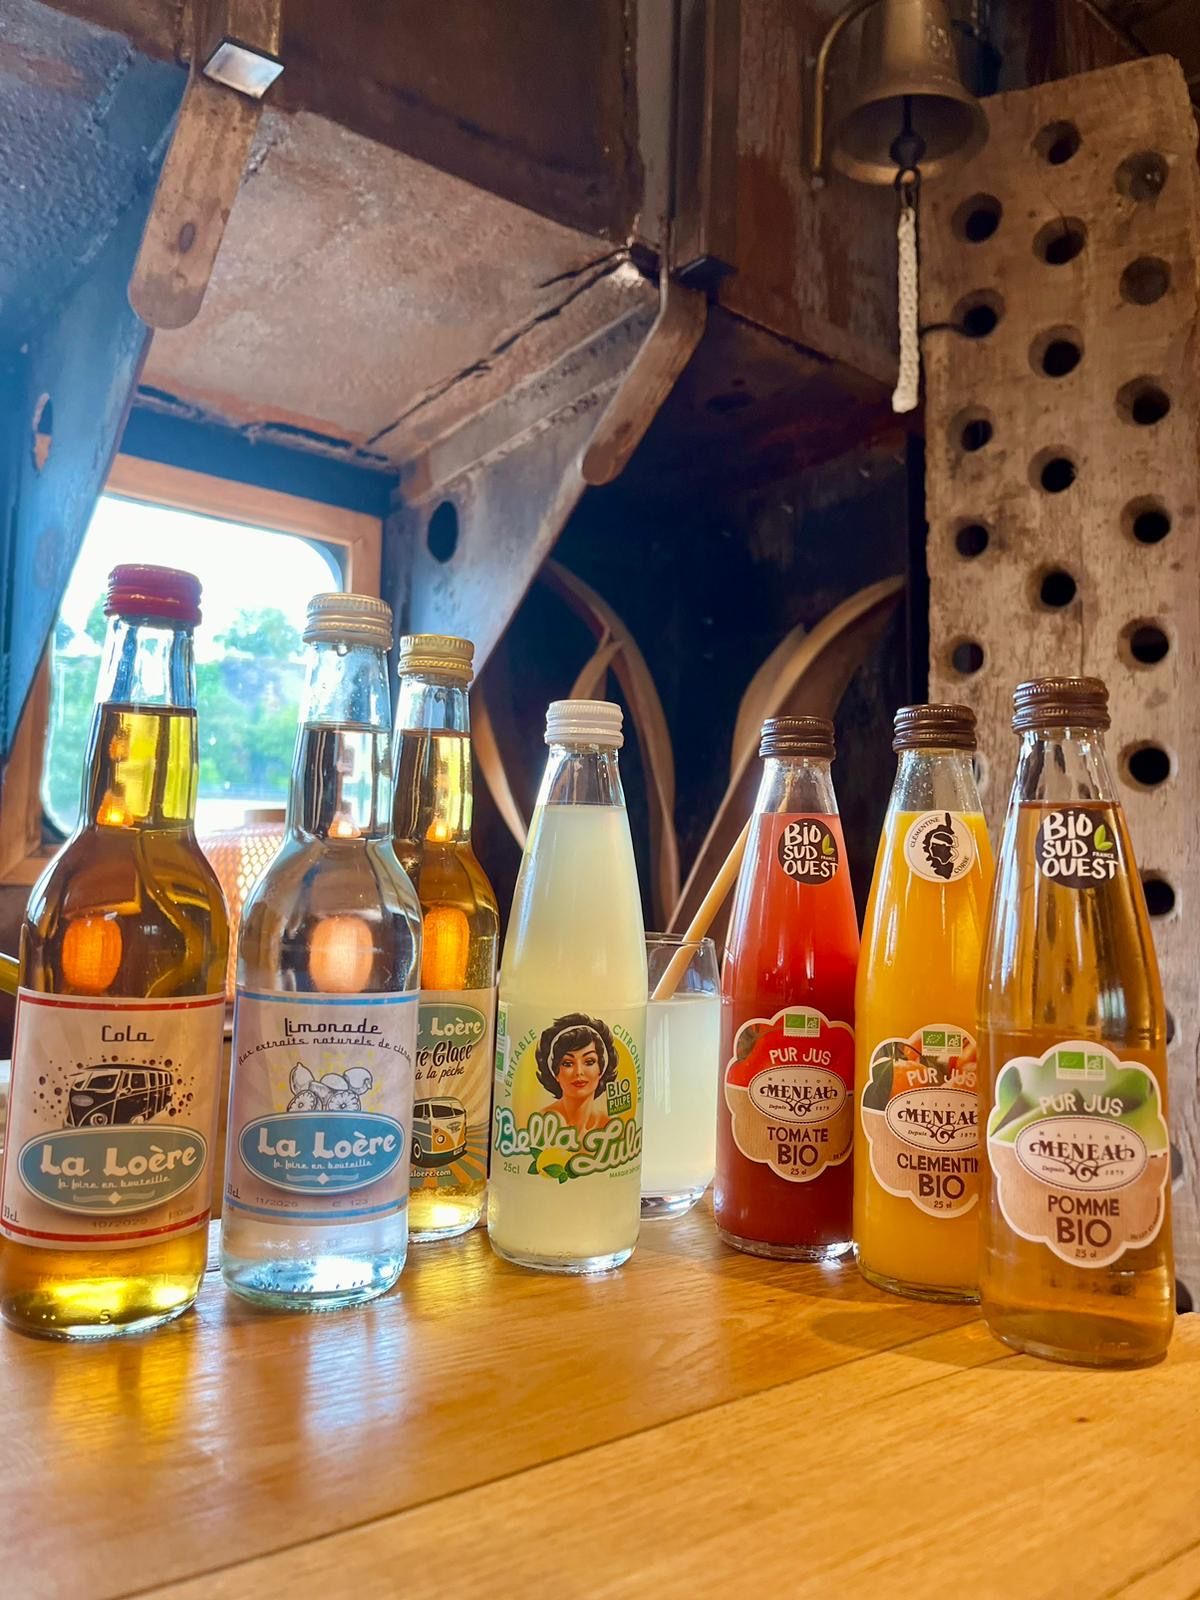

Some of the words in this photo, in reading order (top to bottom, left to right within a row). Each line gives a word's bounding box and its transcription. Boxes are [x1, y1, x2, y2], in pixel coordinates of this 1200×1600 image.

[783, 845, 818, 860] SUD
[1041, 839, 1088, 858] SUD
[1092, 851, 1115, 859] FRANCE
[783, 860, 839, 878] OUEST
[953, 856, 970, 874] CORSE
[1042, 857, 1119, 880] OUEST
[101, 1025, 155, 1043] Cola
[284, 1017, 383, 1037] Limonade
[430, 1017, 482, 1036] Loère
[256, 1035, 309, 1052] extraits
[313, 1036, 375, 1047] naturels
[378, 1037, 392, 1049] de
[432, 1040, 473, 1067] Glacé
[504, 1028, 537, 1098] VÉRITABLE
[769, 1046, 798, 1065] PUR
[802, 1047, 832, 1065] JUS
[426, 1065, 438, 1079] la
[906, 1067, 938, 1087] PUR
[944, 1069, 977, 1088] JUS
[608, 1079, 630, 1098] BIO
[760, 1084, 838, 1100] MENEAU
[609, 1094, 630, 1109] PULPE
[1039, 1095, 1077, 1115] PUR
[1083, 1095, 1124, 1117] JUS
[495, 1107, 580, 1156] Bella
[767, 1127, 829, 1142] TOMATE
[258, 1127, 301, 1157] La
[312, 1131, 397, 1159] Loère
[1029, 1139, 1136, 1161] MENEAU
[40, 1144, 90, 1176] La
[103, 1145, 197, 1177] Loère
[777, 1144, 819, 1167] BIO
[503, 1162, 520, 1174] 25cl
[918, 1173, 965, 1200] BIO
[933, 1200, 944, 1209] 25
[1048, 1195, 1120, 1216] POMME
[1056, 1217, 1111, 1248] BIO
[1075, 1248, 1087, 1258] 25
